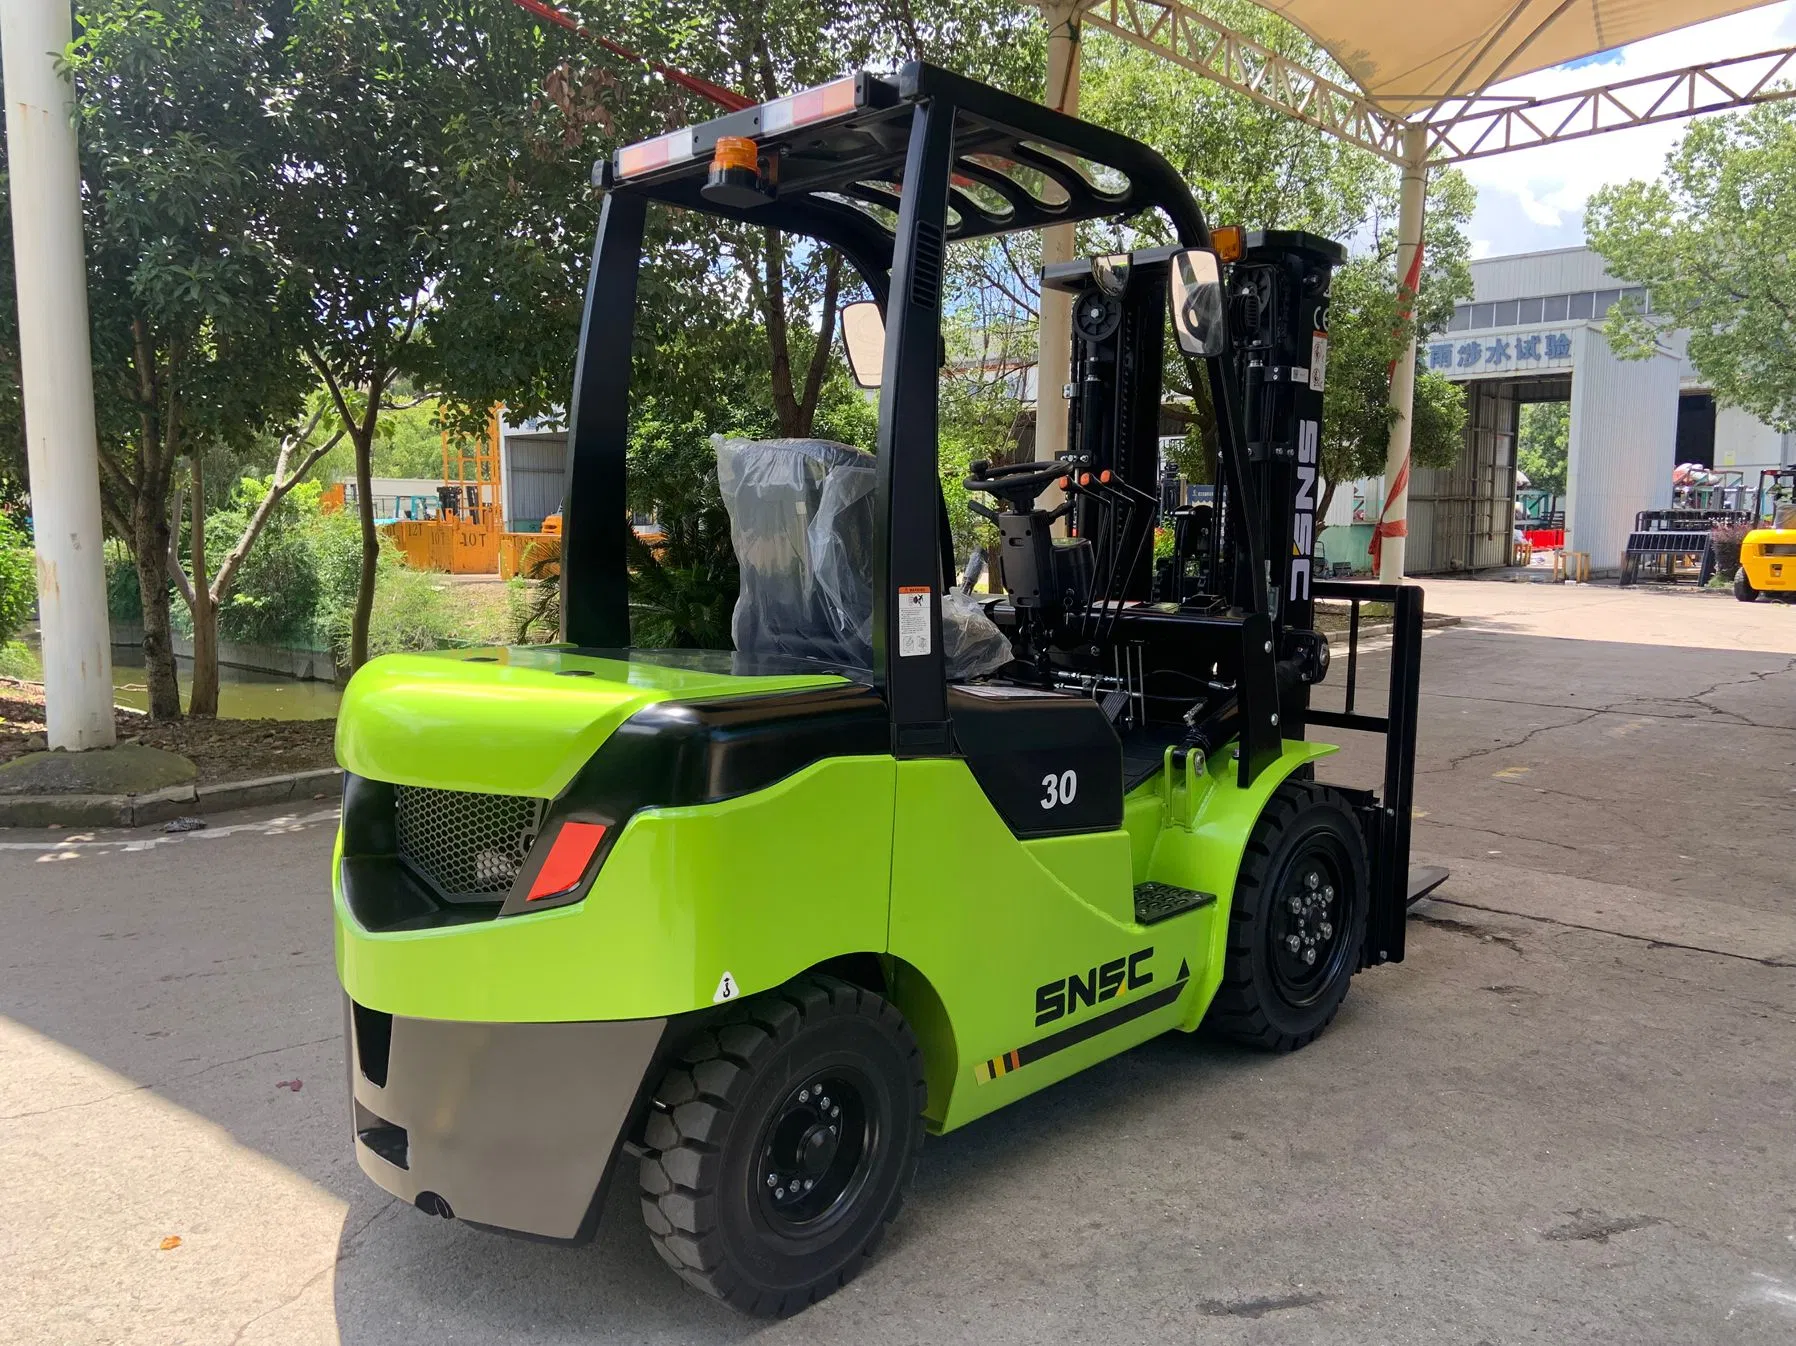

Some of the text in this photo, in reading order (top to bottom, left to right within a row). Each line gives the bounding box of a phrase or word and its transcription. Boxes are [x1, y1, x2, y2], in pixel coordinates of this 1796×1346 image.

[1290, 419, 1318, 601] SNSC
[1040, 769, 1077, 809] 30
[1035, 946, 1154, 1028] SNSC
